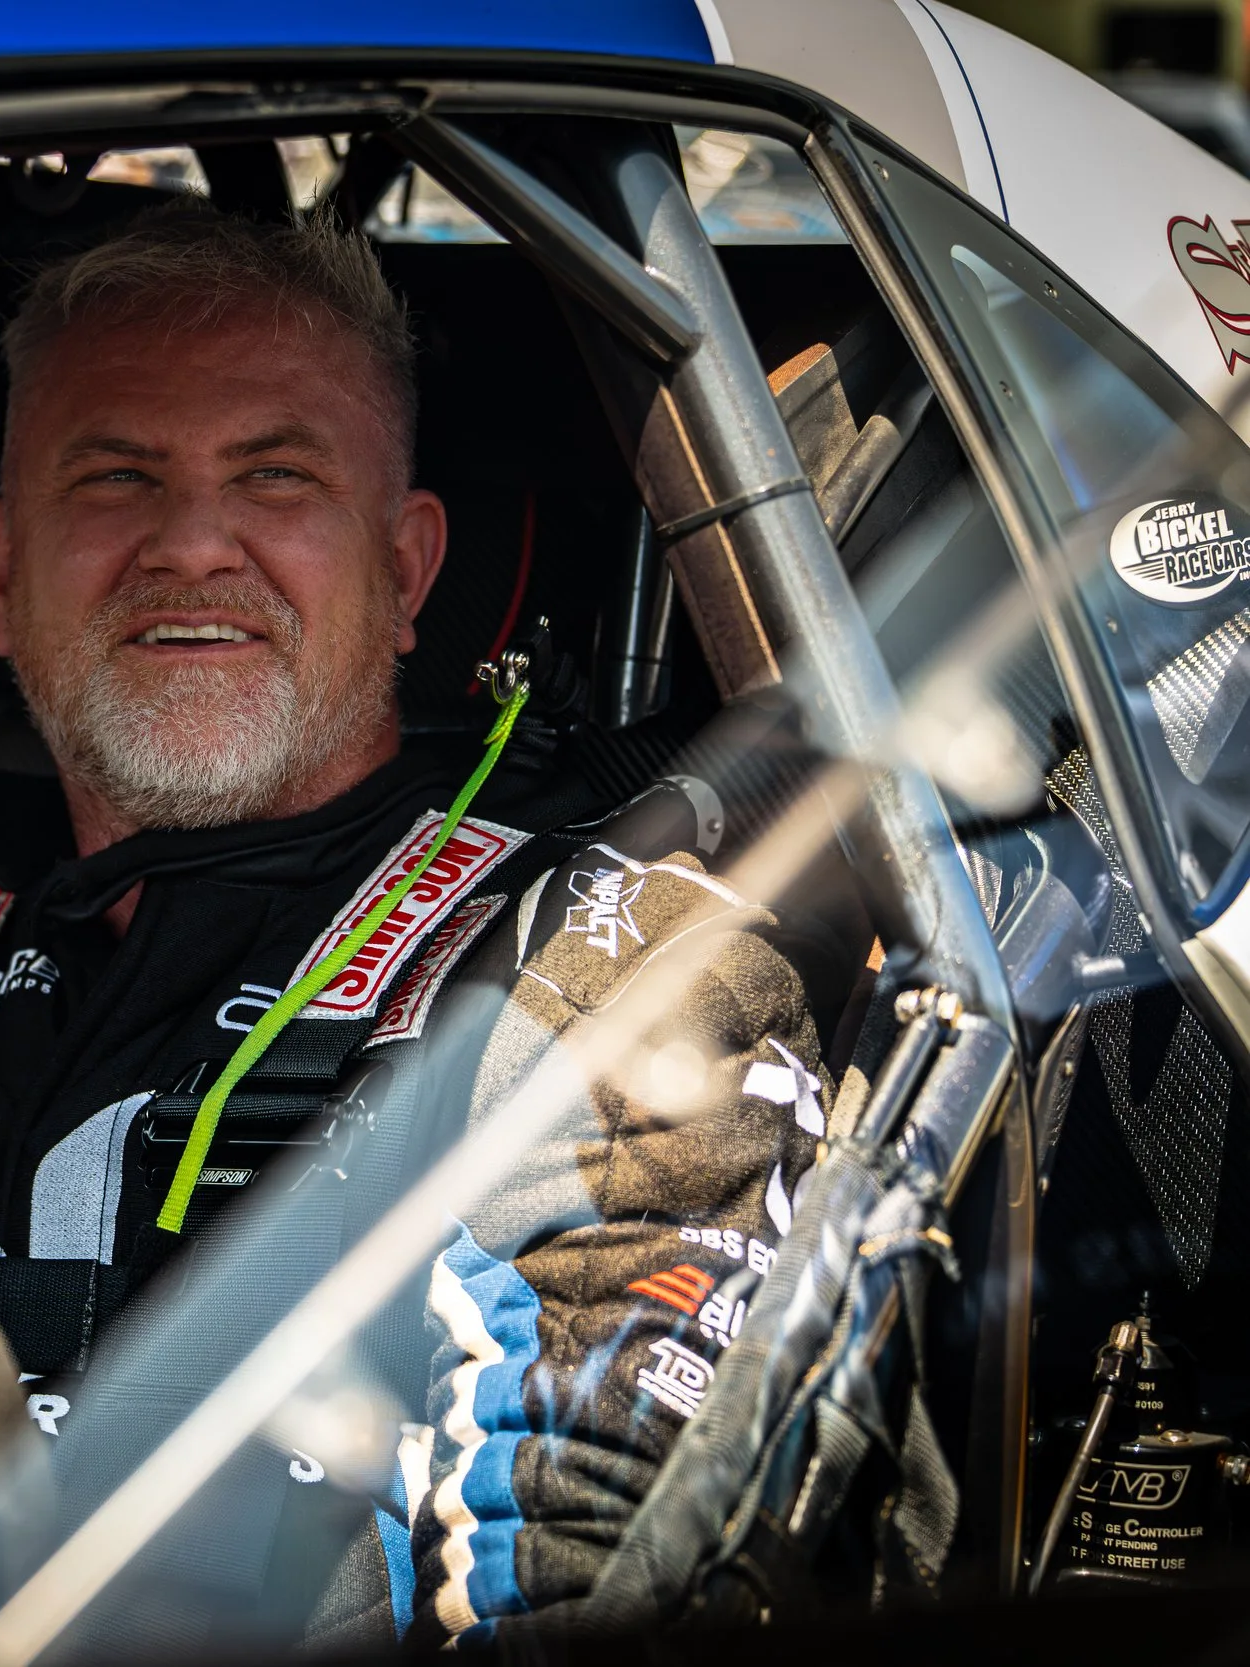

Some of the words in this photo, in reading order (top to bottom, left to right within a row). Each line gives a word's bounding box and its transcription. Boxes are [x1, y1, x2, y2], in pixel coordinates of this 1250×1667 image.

[1152, 501, 1197, 522] JERRY
[1136, 508, 1234, 557] BICKEL
[197, 1169, 247, 1185] SIMPSON
[1123, 1518, 1204, 1540] CONTROLLER
[1115, 1539, 1159, 1553] PENDING
[1107, 1553, 1159, 1570] STREET
[1160, 1557, 1187, 1571] USE
